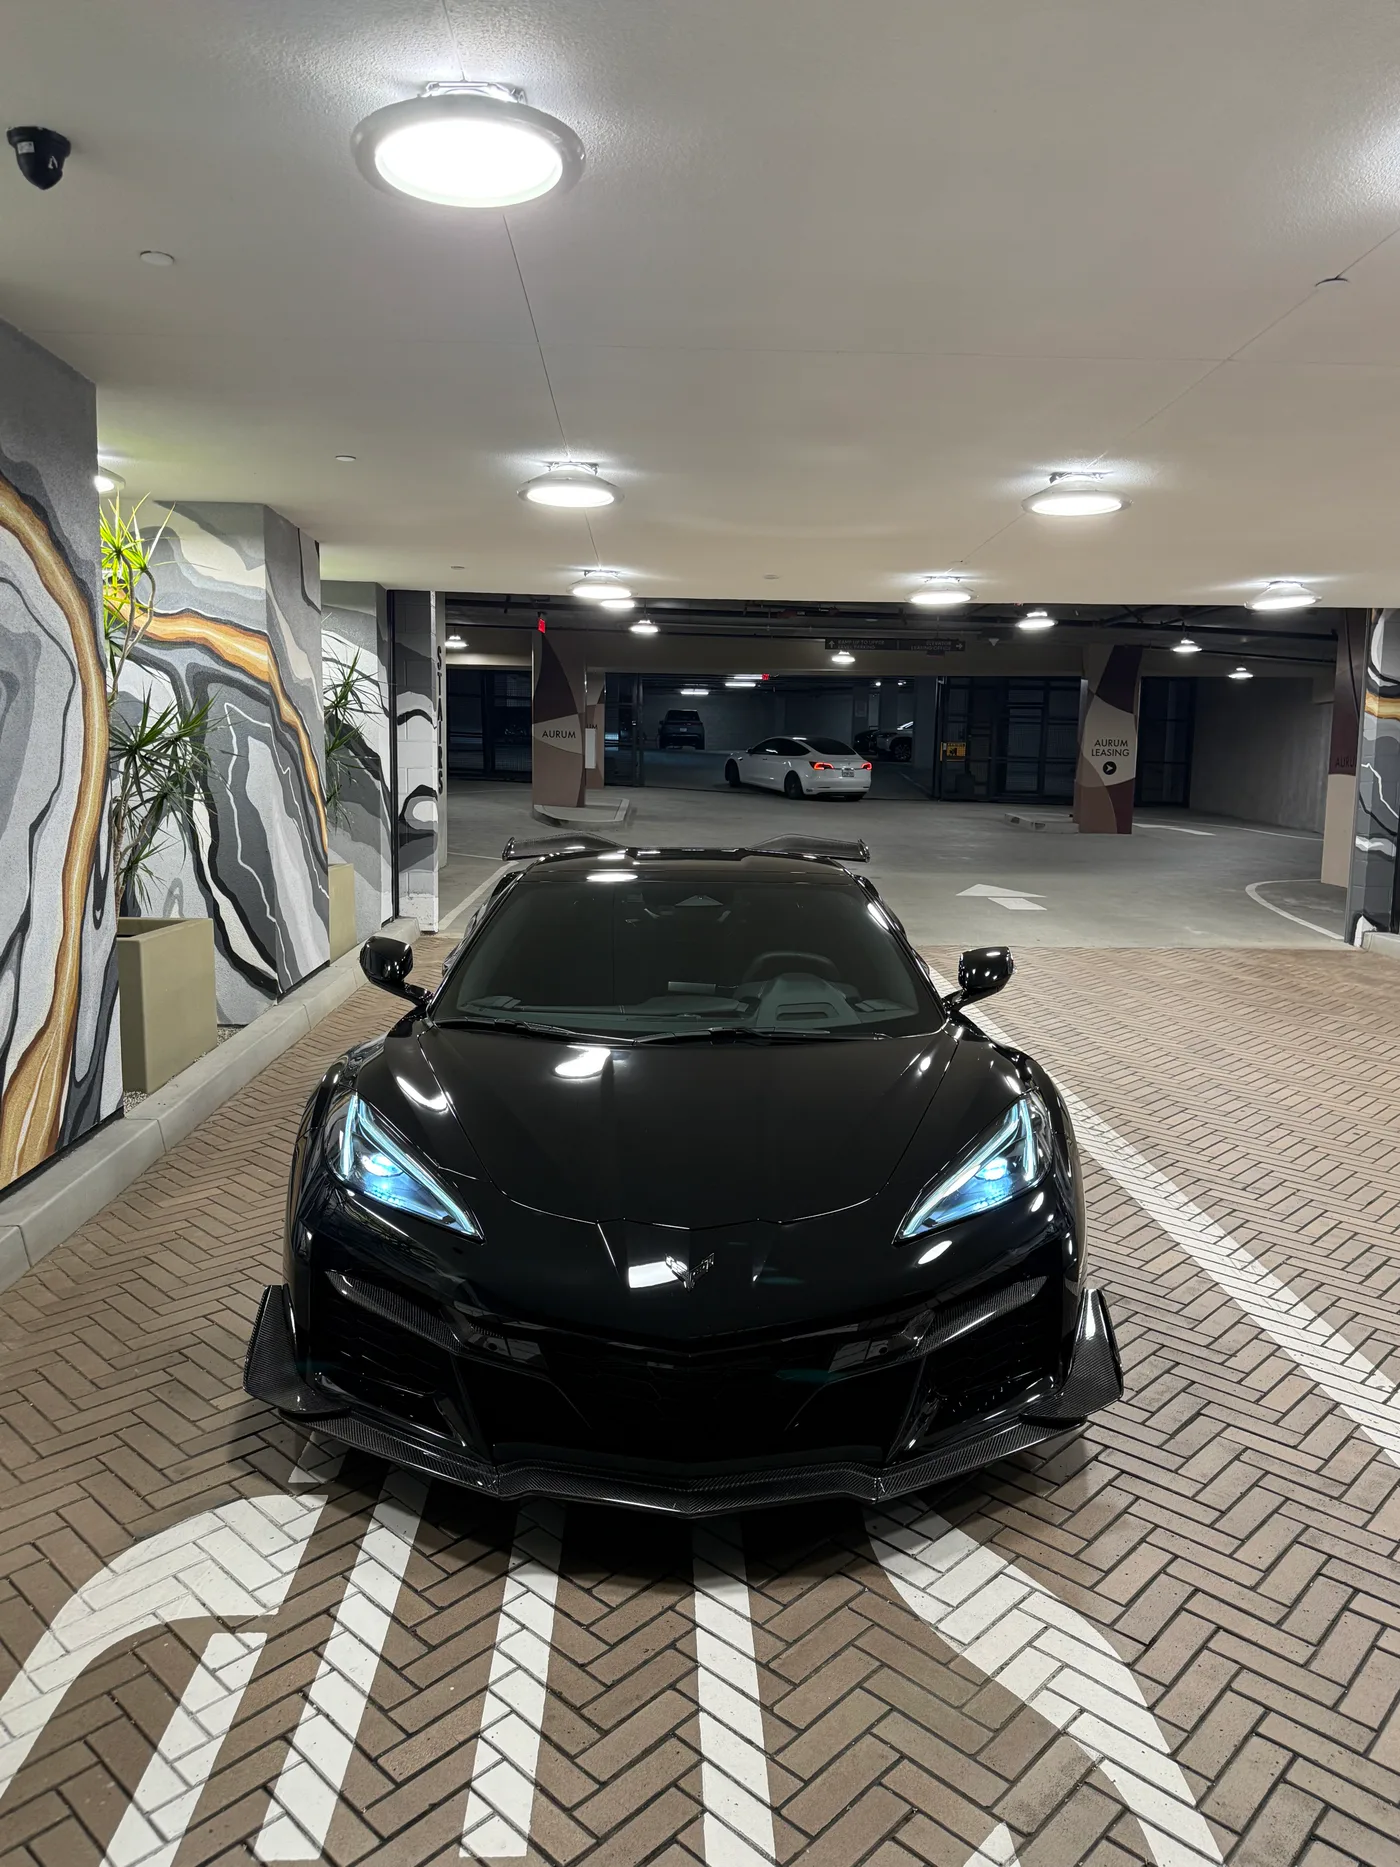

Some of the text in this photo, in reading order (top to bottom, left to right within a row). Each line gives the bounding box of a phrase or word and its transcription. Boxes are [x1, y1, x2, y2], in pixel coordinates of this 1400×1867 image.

[542, 730, 576, 739] AURUM
[1094, 739, 1128, 747] AURUM
[1335, 755, 1356, 768] AURU
